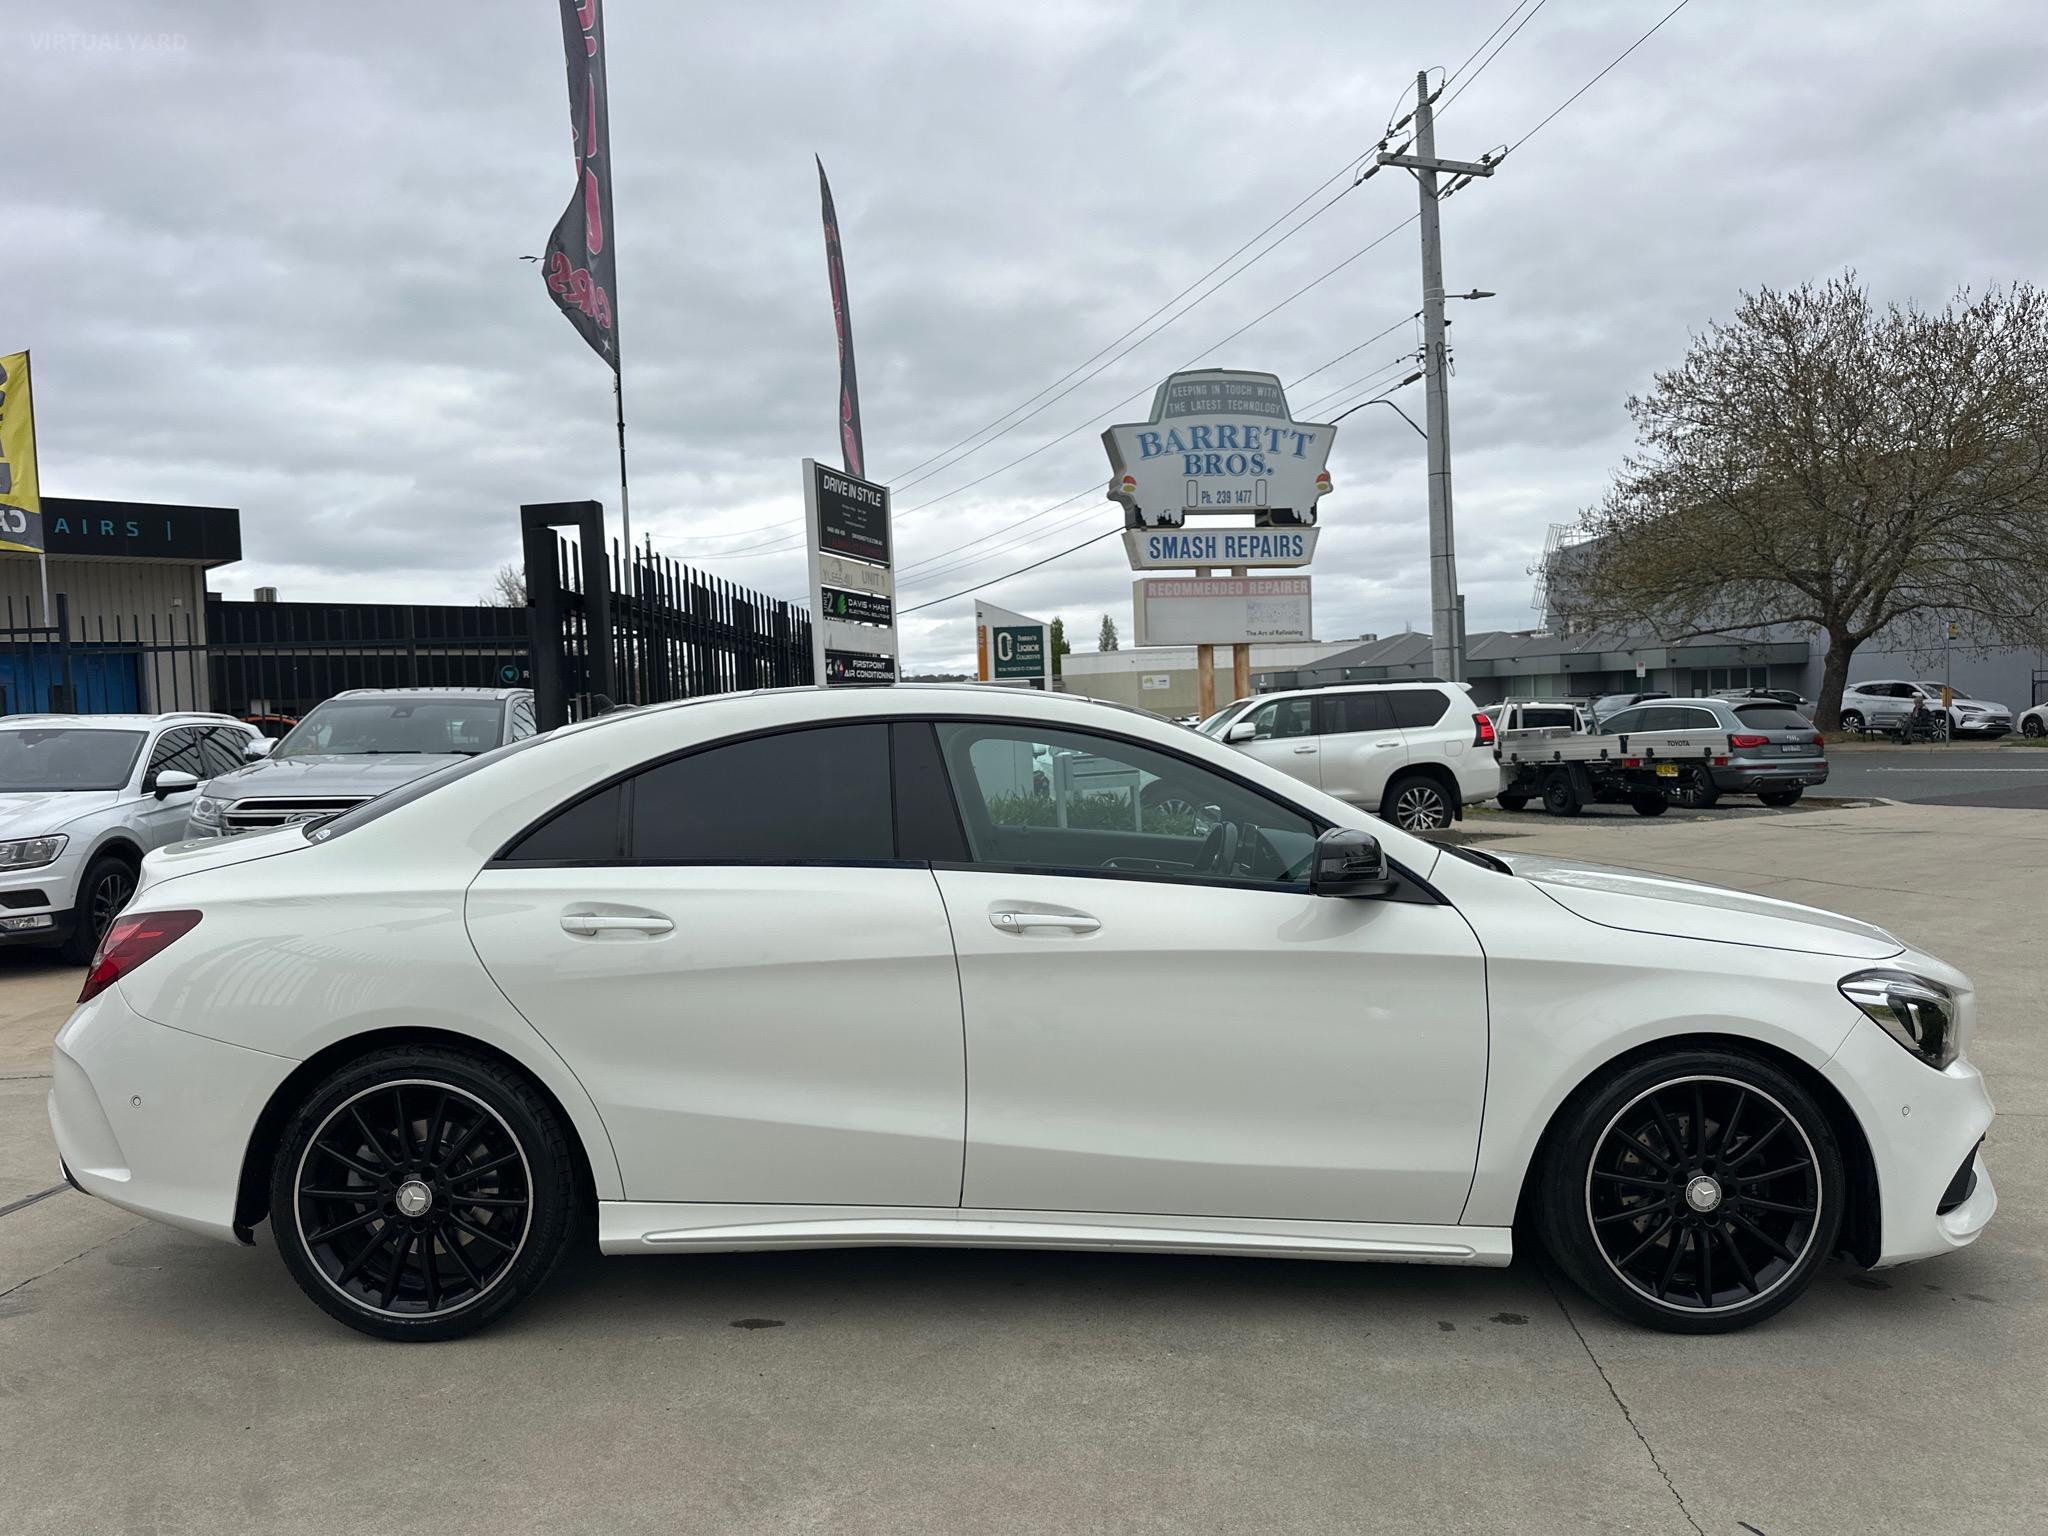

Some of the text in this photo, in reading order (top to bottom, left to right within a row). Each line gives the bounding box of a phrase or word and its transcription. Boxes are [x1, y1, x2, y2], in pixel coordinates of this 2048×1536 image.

[1172, 384, 1278, 399] KEEPING IN TOUCH WITH
[1169, 399, 1282, 414] THE LATEST TECHNOLOGY
[1136, 423, 1316, 460] BARRETT
[1183, 453, 1274, 477] BROS.
[823, 474, 882, 508] DRIVE IN STYLE
[1216, 490, 1232, 504] 239
[1235, 489, 1252, 504] 1477
[1149, 534, 1304, 560] SMASH REPAIRS
[1148, 579, 1309, 597] RECOMMENDED REPAIRER
[847, 598, 868, 610] DAVIS
[872, 602, 890, 613] HART
[826, 663, 834, 676] 4
[843, 669, 895, 680] AIR CONDITIONING
[1667, 739, 1690, 747] TOYOTA
